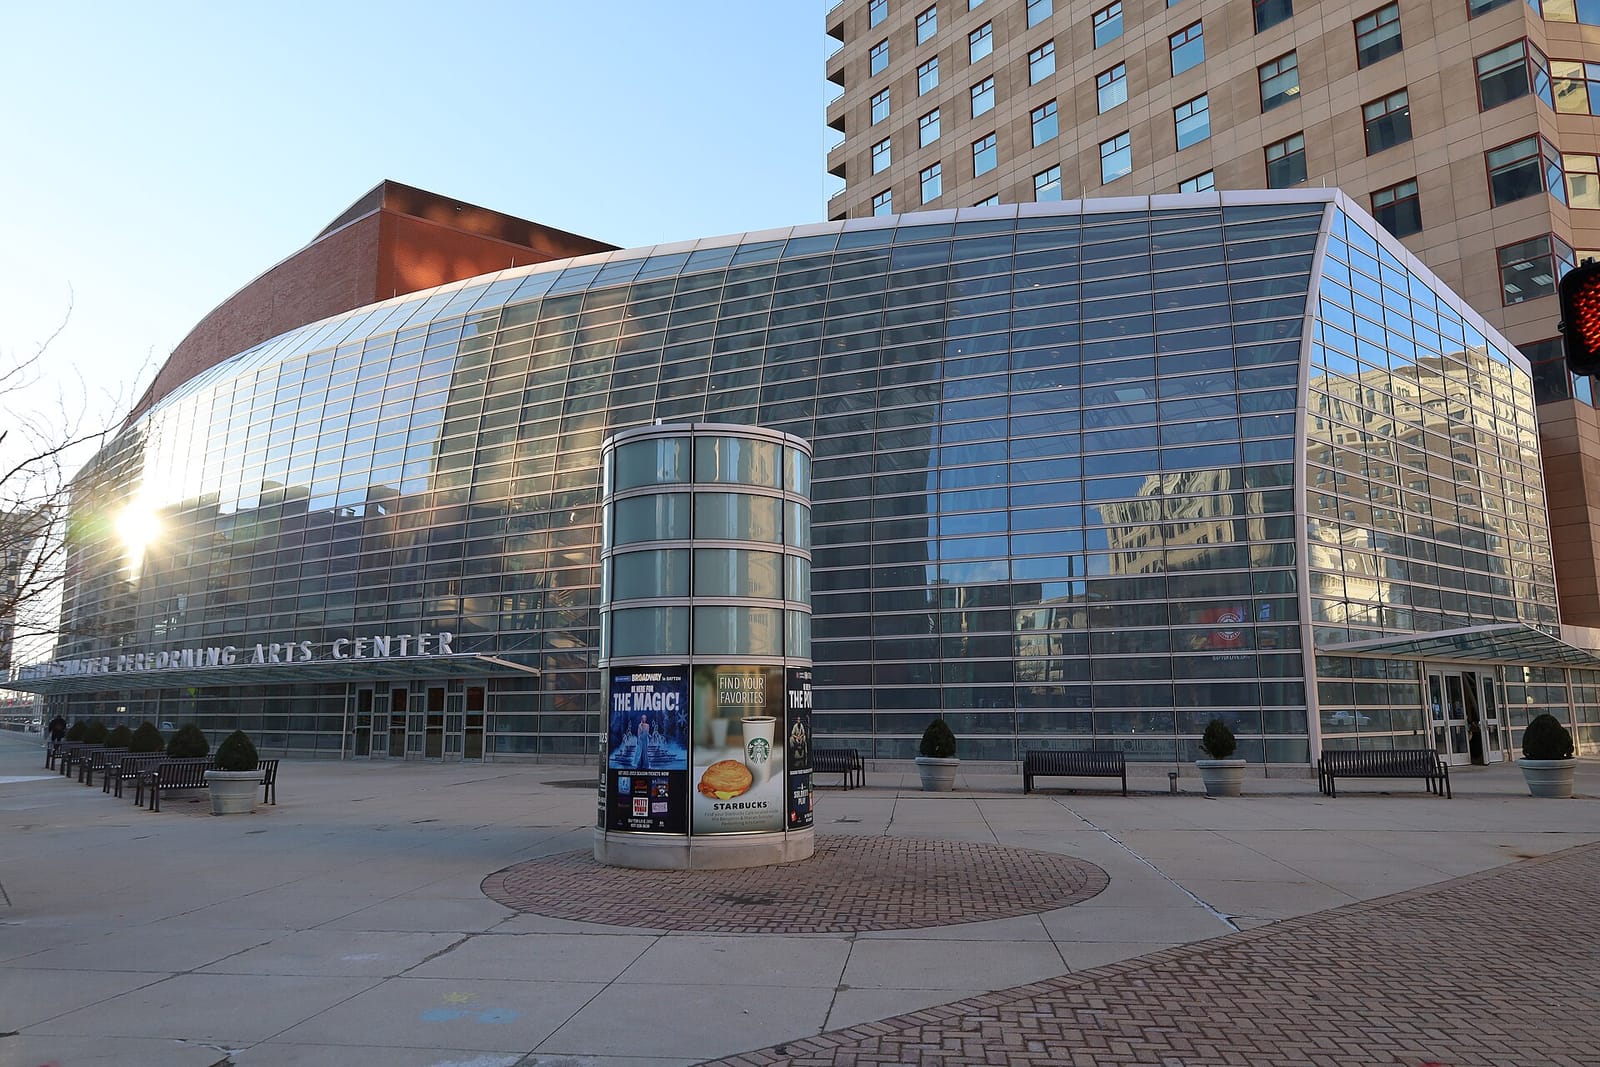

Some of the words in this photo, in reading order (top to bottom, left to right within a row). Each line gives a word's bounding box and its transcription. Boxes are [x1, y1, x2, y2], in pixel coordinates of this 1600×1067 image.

[117, 646, 236, 672] PERFORMING
[251, 640, 312, 664] ARTS
[333, 632, 453, 660] CENTER
[631, 673, 662, 682] BROADWAY
[720, 677, 740, 690] FIND
[742, 677, 764, 690] YOUR
[613, 693, 631, 711] THE
[633, 692, 680, 711] MAGIC!
[720, 691, 764, 704] FAVORITES
[789, 690, 803, 709] THE
[713, 801, 768, 811] STARBUCKS
